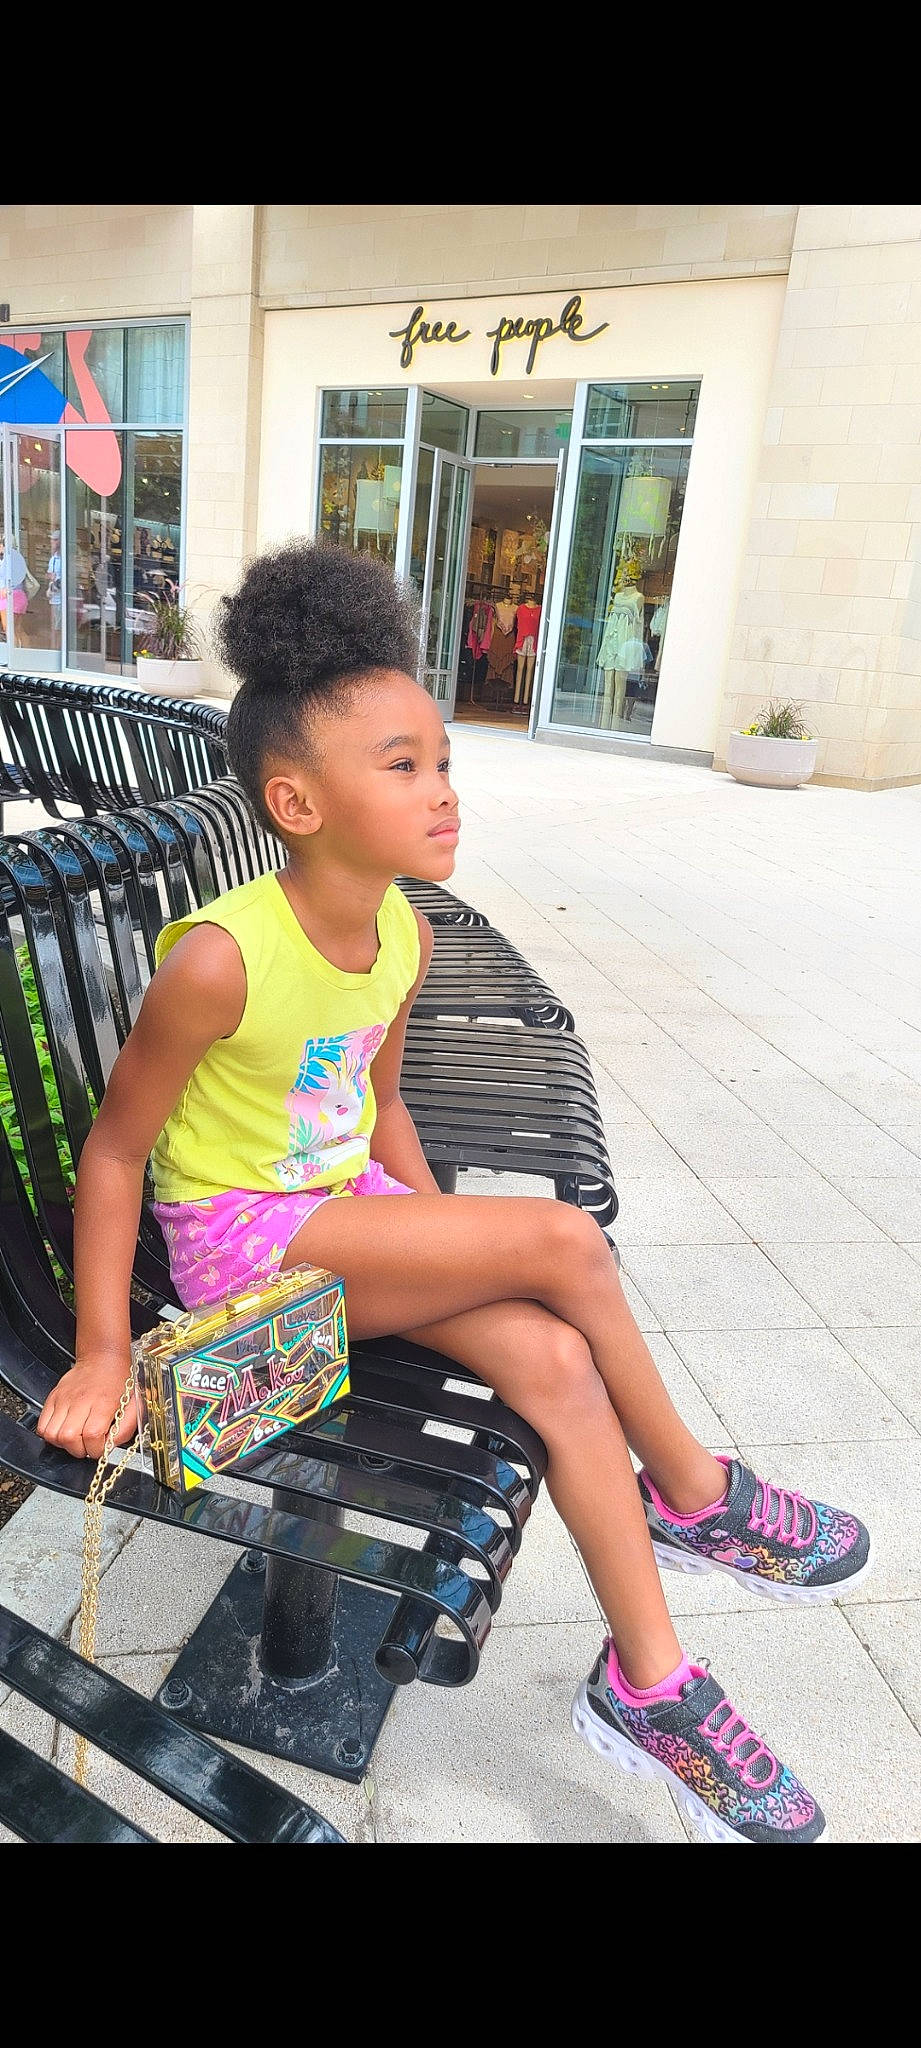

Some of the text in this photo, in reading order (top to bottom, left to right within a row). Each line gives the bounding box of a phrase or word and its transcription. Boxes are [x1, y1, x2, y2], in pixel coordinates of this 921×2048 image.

[389, 296, 609, 375] free people
[312, 1330, 333, 1348] Sun
[185, 1362, 226, 1390] Peace
